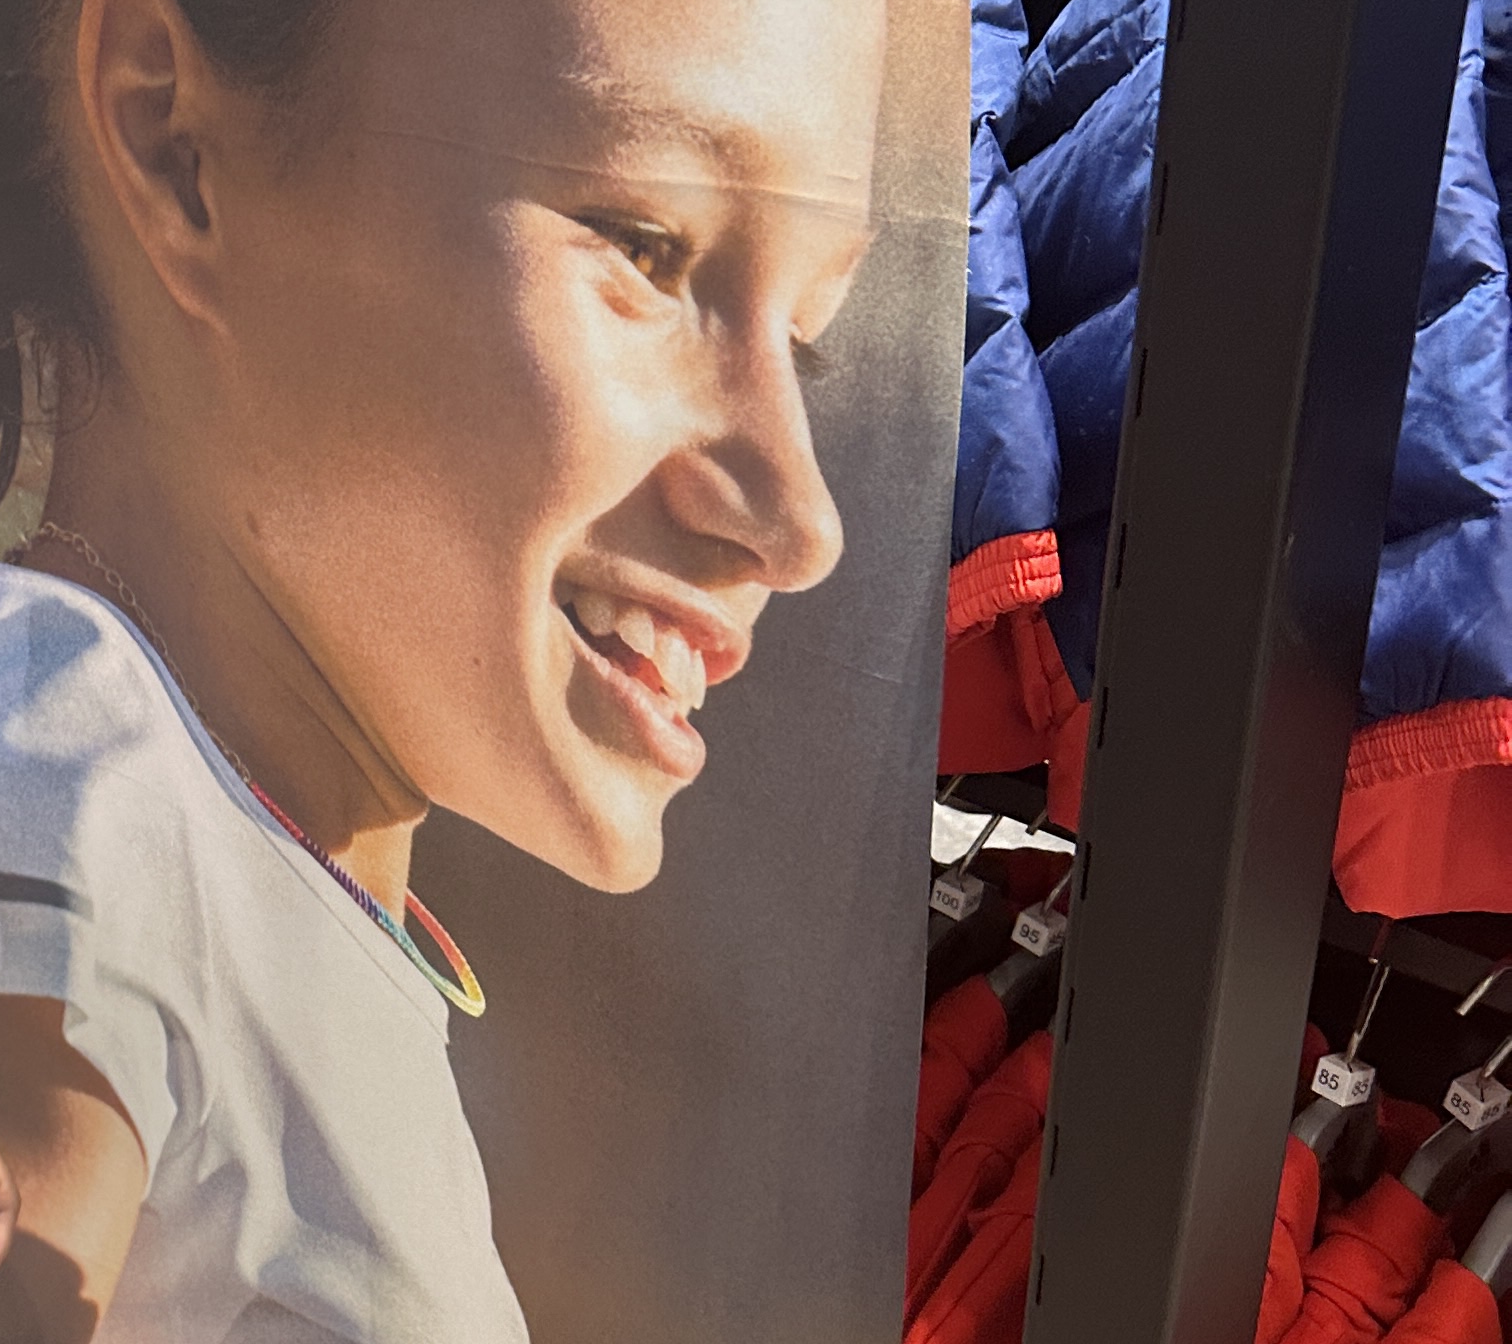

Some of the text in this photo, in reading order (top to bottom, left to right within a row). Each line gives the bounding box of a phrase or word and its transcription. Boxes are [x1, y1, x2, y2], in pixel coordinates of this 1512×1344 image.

[935, 890, 959, 910] 100
[1020, 923, 1040, 944] 95
[1318, 1068, 1340, 1090] 85
[1450, 1092, 1472, 1116] 85
